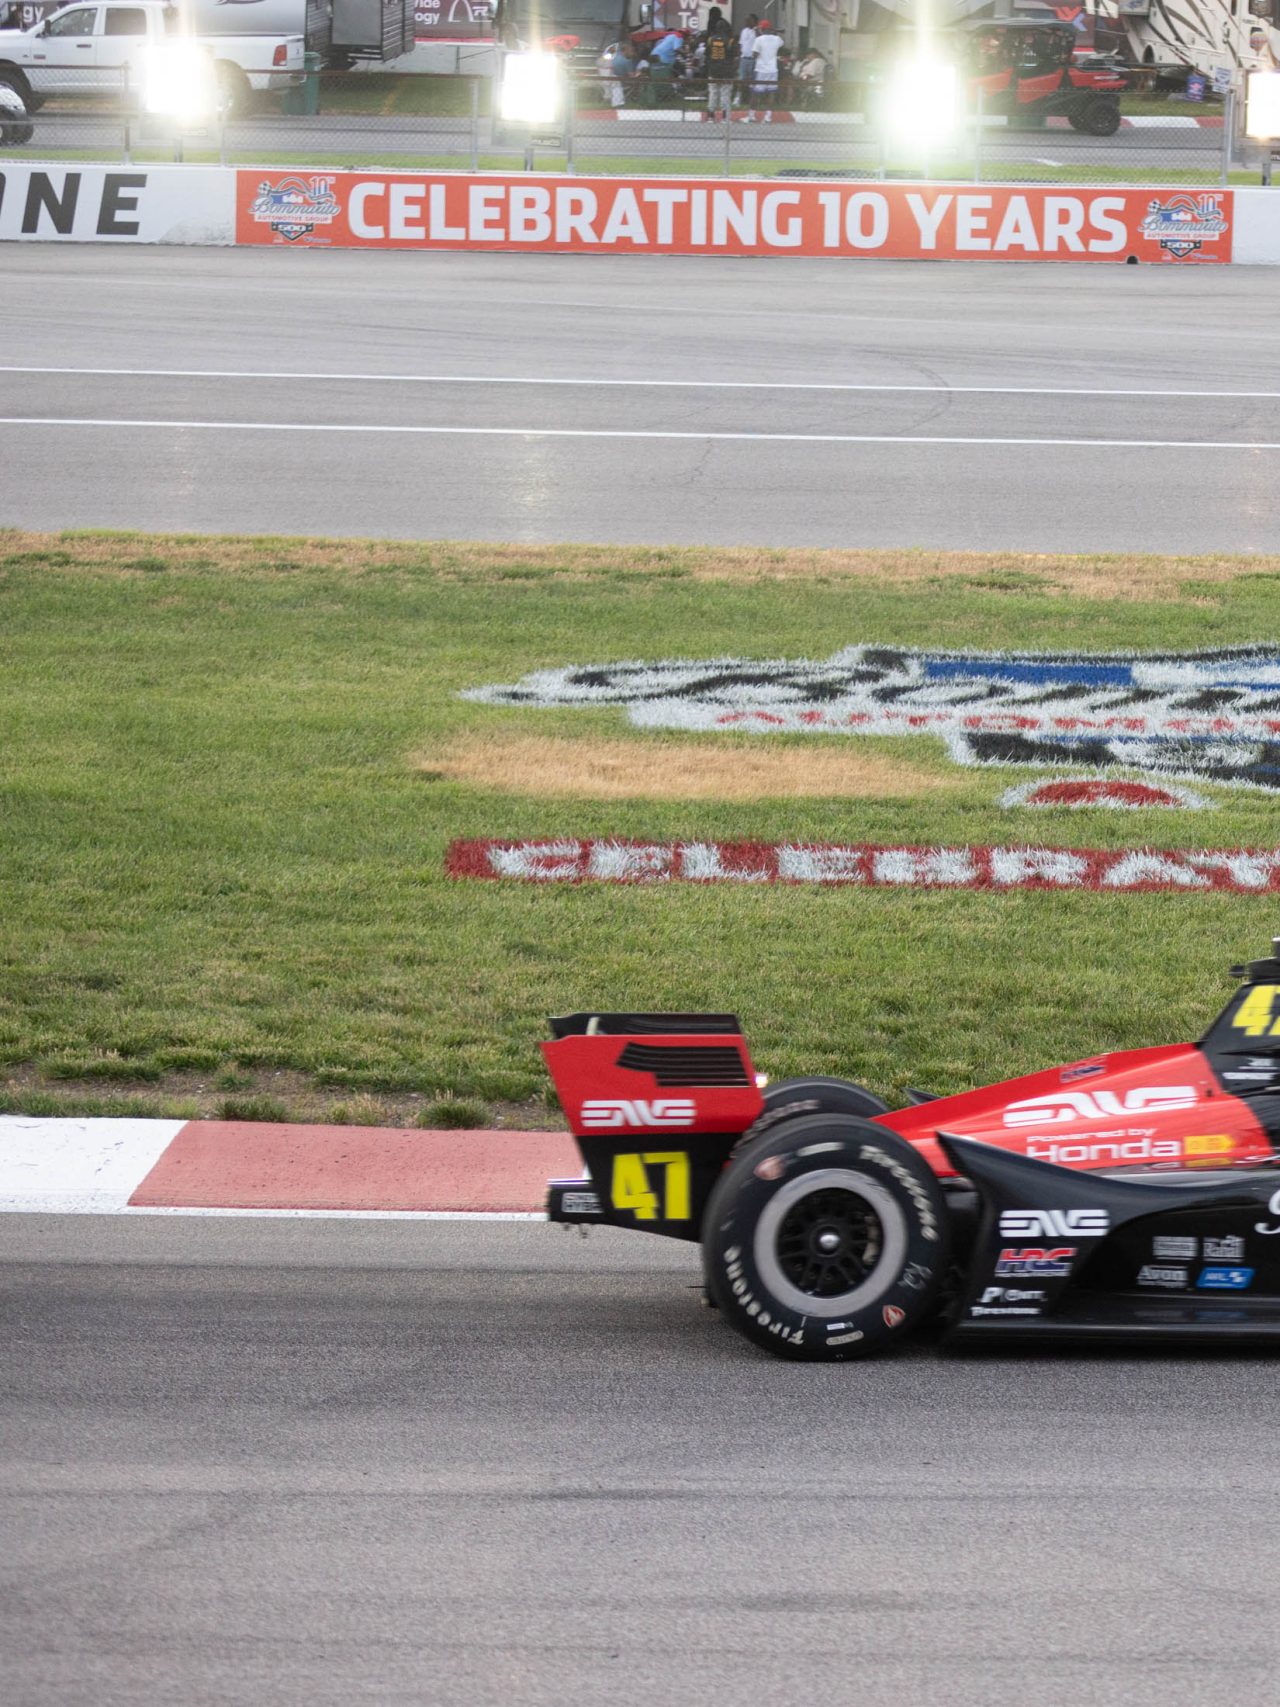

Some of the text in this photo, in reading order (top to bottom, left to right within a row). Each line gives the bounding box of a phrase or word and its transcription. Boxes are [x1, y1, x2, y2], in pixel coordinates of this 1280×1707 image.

[0, 172, 147, 236] NE
[348, 181, 1128, 254] CELEBRATING 10 YEARS
[1026, 1138, 1182, 1163] Honda
[611, 1151, 690, 1220] 47
[723, 1245, 805, 1346] Firestone
